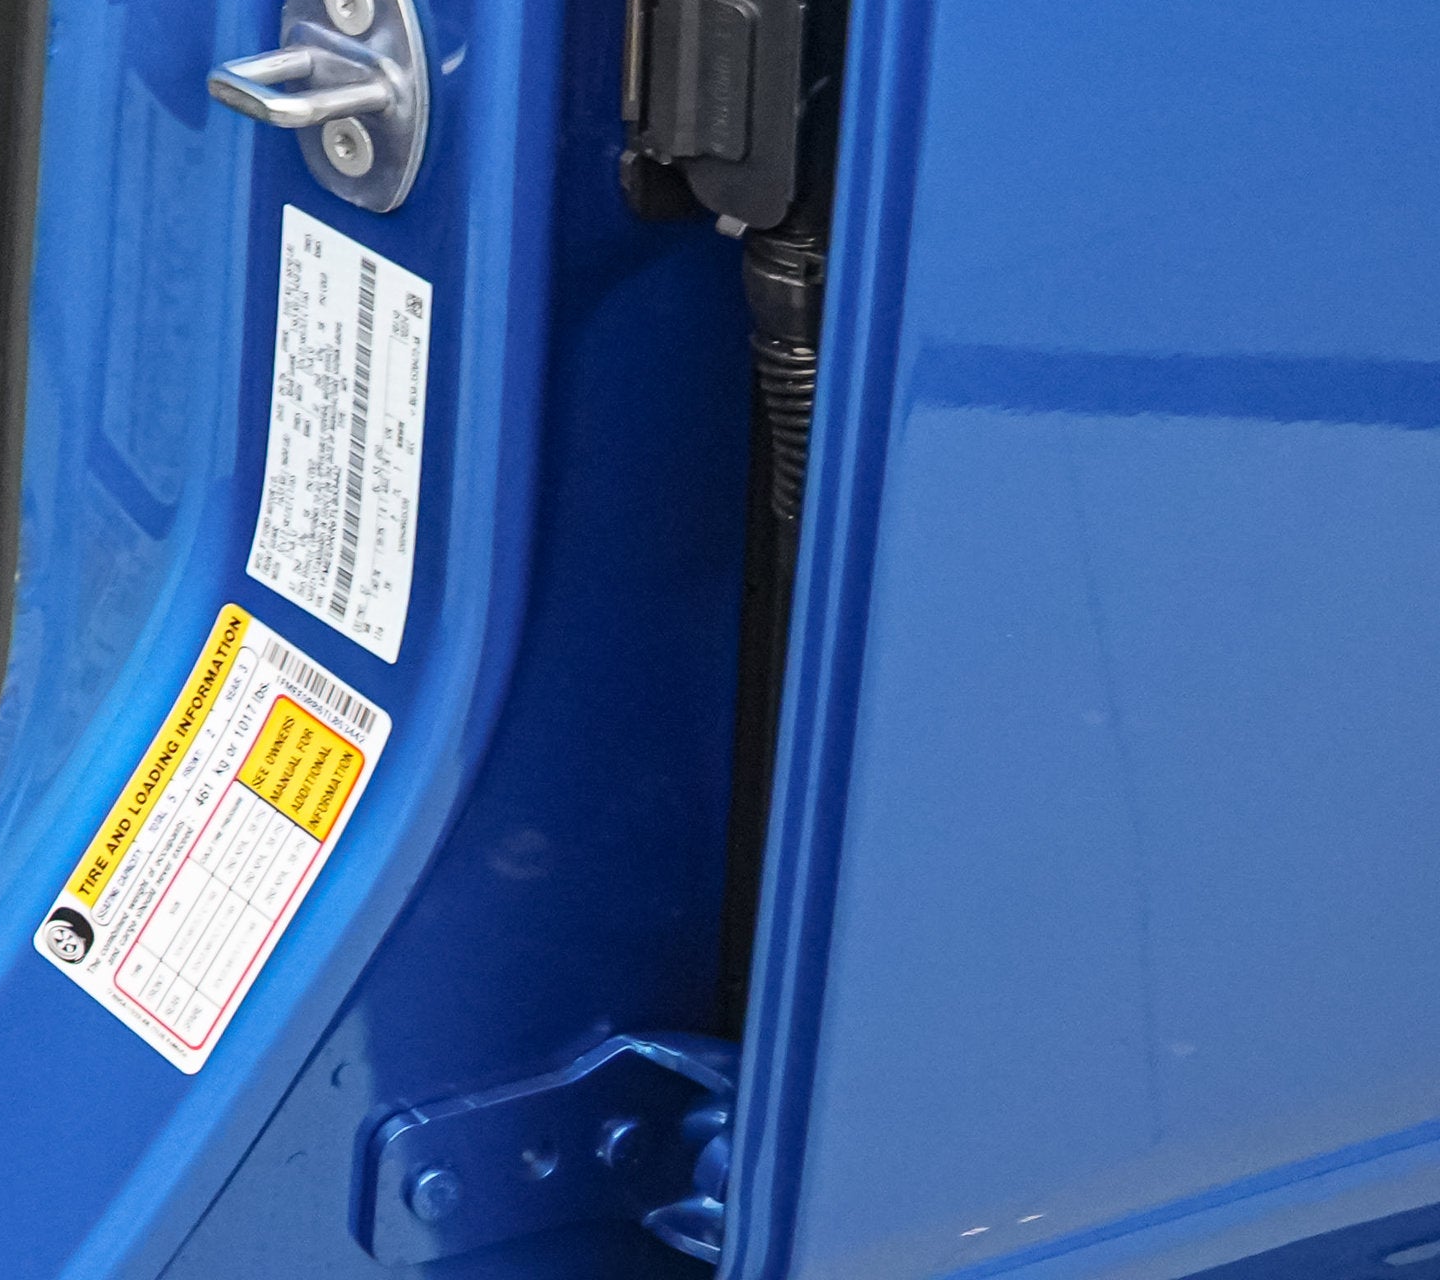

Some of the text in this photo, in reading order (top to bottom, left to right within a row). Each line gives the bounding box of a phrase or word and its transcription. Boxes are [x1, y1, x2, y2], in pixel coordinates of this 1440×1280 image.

[78, 615, 242, 898] TIRE AND LOADING INFORMATION
[193, 781, 213, 807] 461
[211, 756, 230, 778] kg
[224, 741, 238, 758] or
[232, 703, 257, 739] 1017
[250, 764, 269, 790] SEE
[268, 726, 315, 803] MANUAL FOR
[289, 742, 333, 813] ADDITIONAL
[304, 749, 356, 831] INFORMATION
